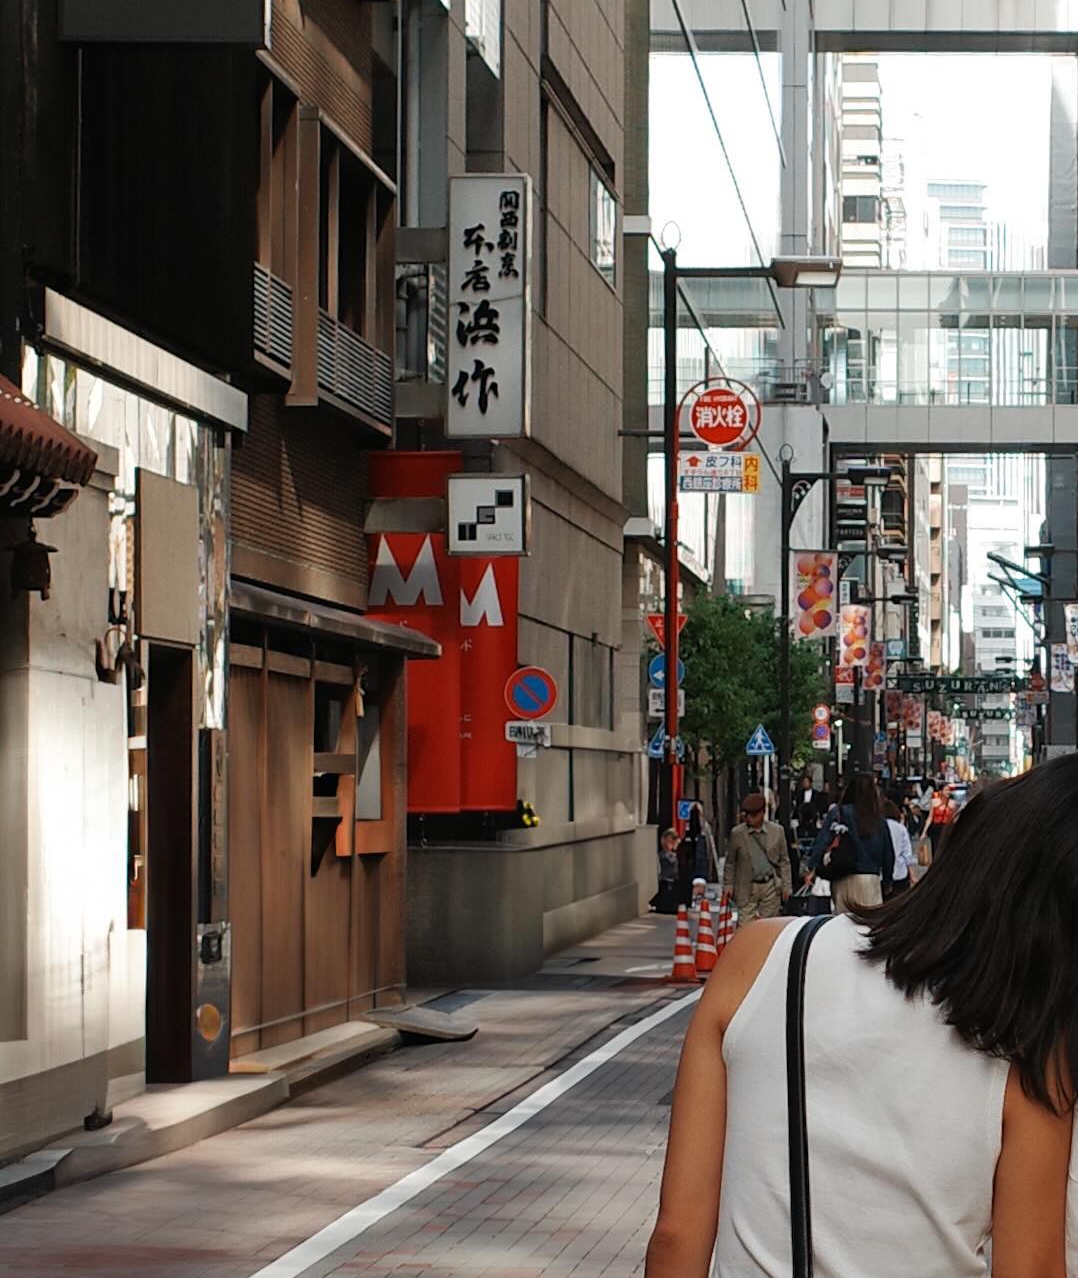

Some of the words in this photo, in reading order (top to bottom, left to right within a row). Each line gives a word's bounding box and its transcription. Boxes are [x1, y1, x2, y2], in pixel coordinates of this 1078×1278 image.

[696, 405, 743, 428] 消火栓
[706, 456, 742, 468] 皮フ科
[745, 456, 759, 491] 内科
